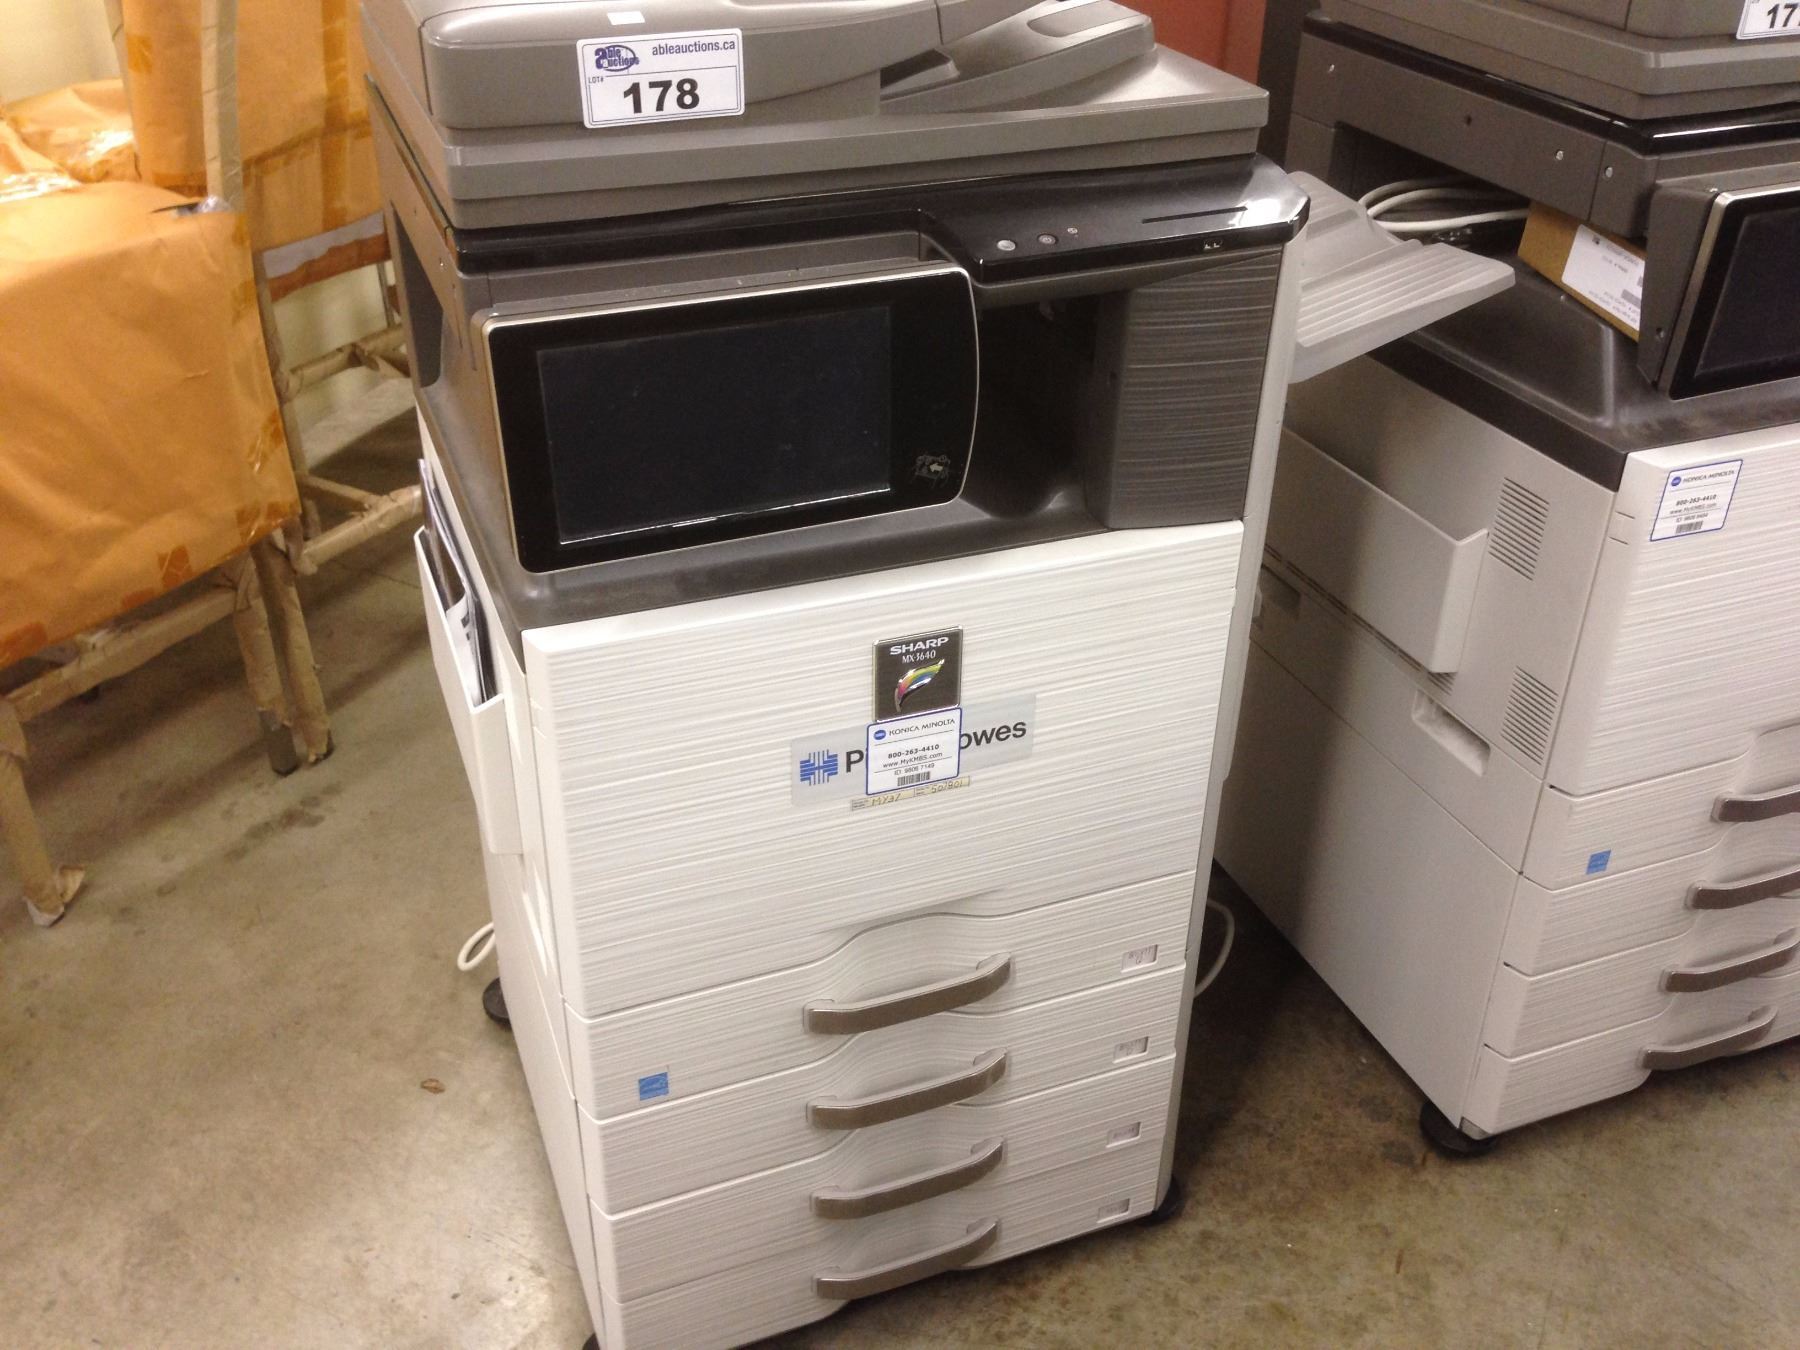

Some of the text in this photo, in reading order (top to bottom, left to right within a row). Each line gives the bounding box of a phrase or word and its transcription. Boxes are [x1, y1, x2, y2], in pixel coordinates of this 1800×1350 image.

[1767, 3, 1800, 28] 17
[652, 40, 735, 56] ableauctions.ca
[623, 78, 700, 114] 178
[890, 637, 949, 655] SHARP
[902, 650, 936, 664] MX-3640
[889, 718, 955, 736] KONICA MINOLTA
[846, 721, 1027, 773] P owes
[888, 744, 939, 759] 800-263-4410
